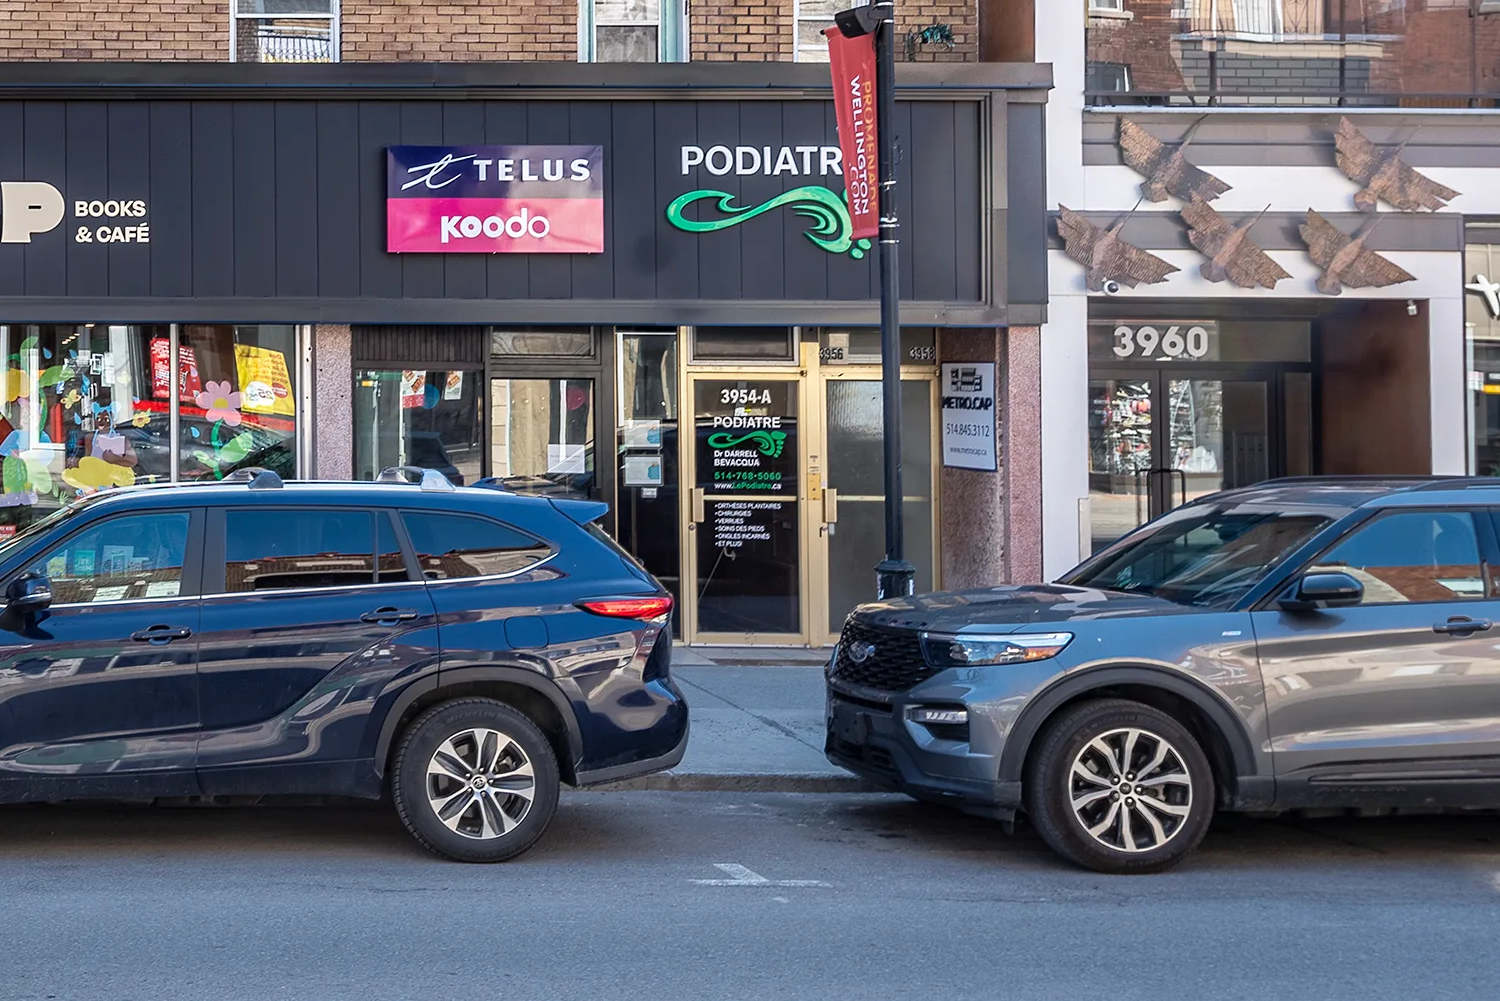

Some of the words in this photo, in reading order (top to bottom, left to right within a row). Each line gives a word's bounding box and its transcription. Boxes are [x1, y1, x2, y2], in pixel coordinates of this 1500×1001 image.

[850, 75, 870, 214] WELLINGTON
[862, 80, 878, 212] PROMENADE
[681, 144, 844, 176] PODIATR
[472, 158, 592, 183] TELUS
[74, 200, 147, 218] BOOKS
[75, 226, 93, 244] &
[96, 222, 151, 244] CAFÉ
[1112, 325, 1209, 358] 3960
[819, 347, 844, 360] 3956
[909, 346, 936, 360] 3958
[713, 416, 782, 428] PODIATRE
[946, 422, 990, 438] 514.845.3112
[713, 450, 724, 458] Dr
[724, 450, 759, 458] DARRELL
[713, 458, 761, 467] BEVACQUA
[717, 540, 726, 548] ET
